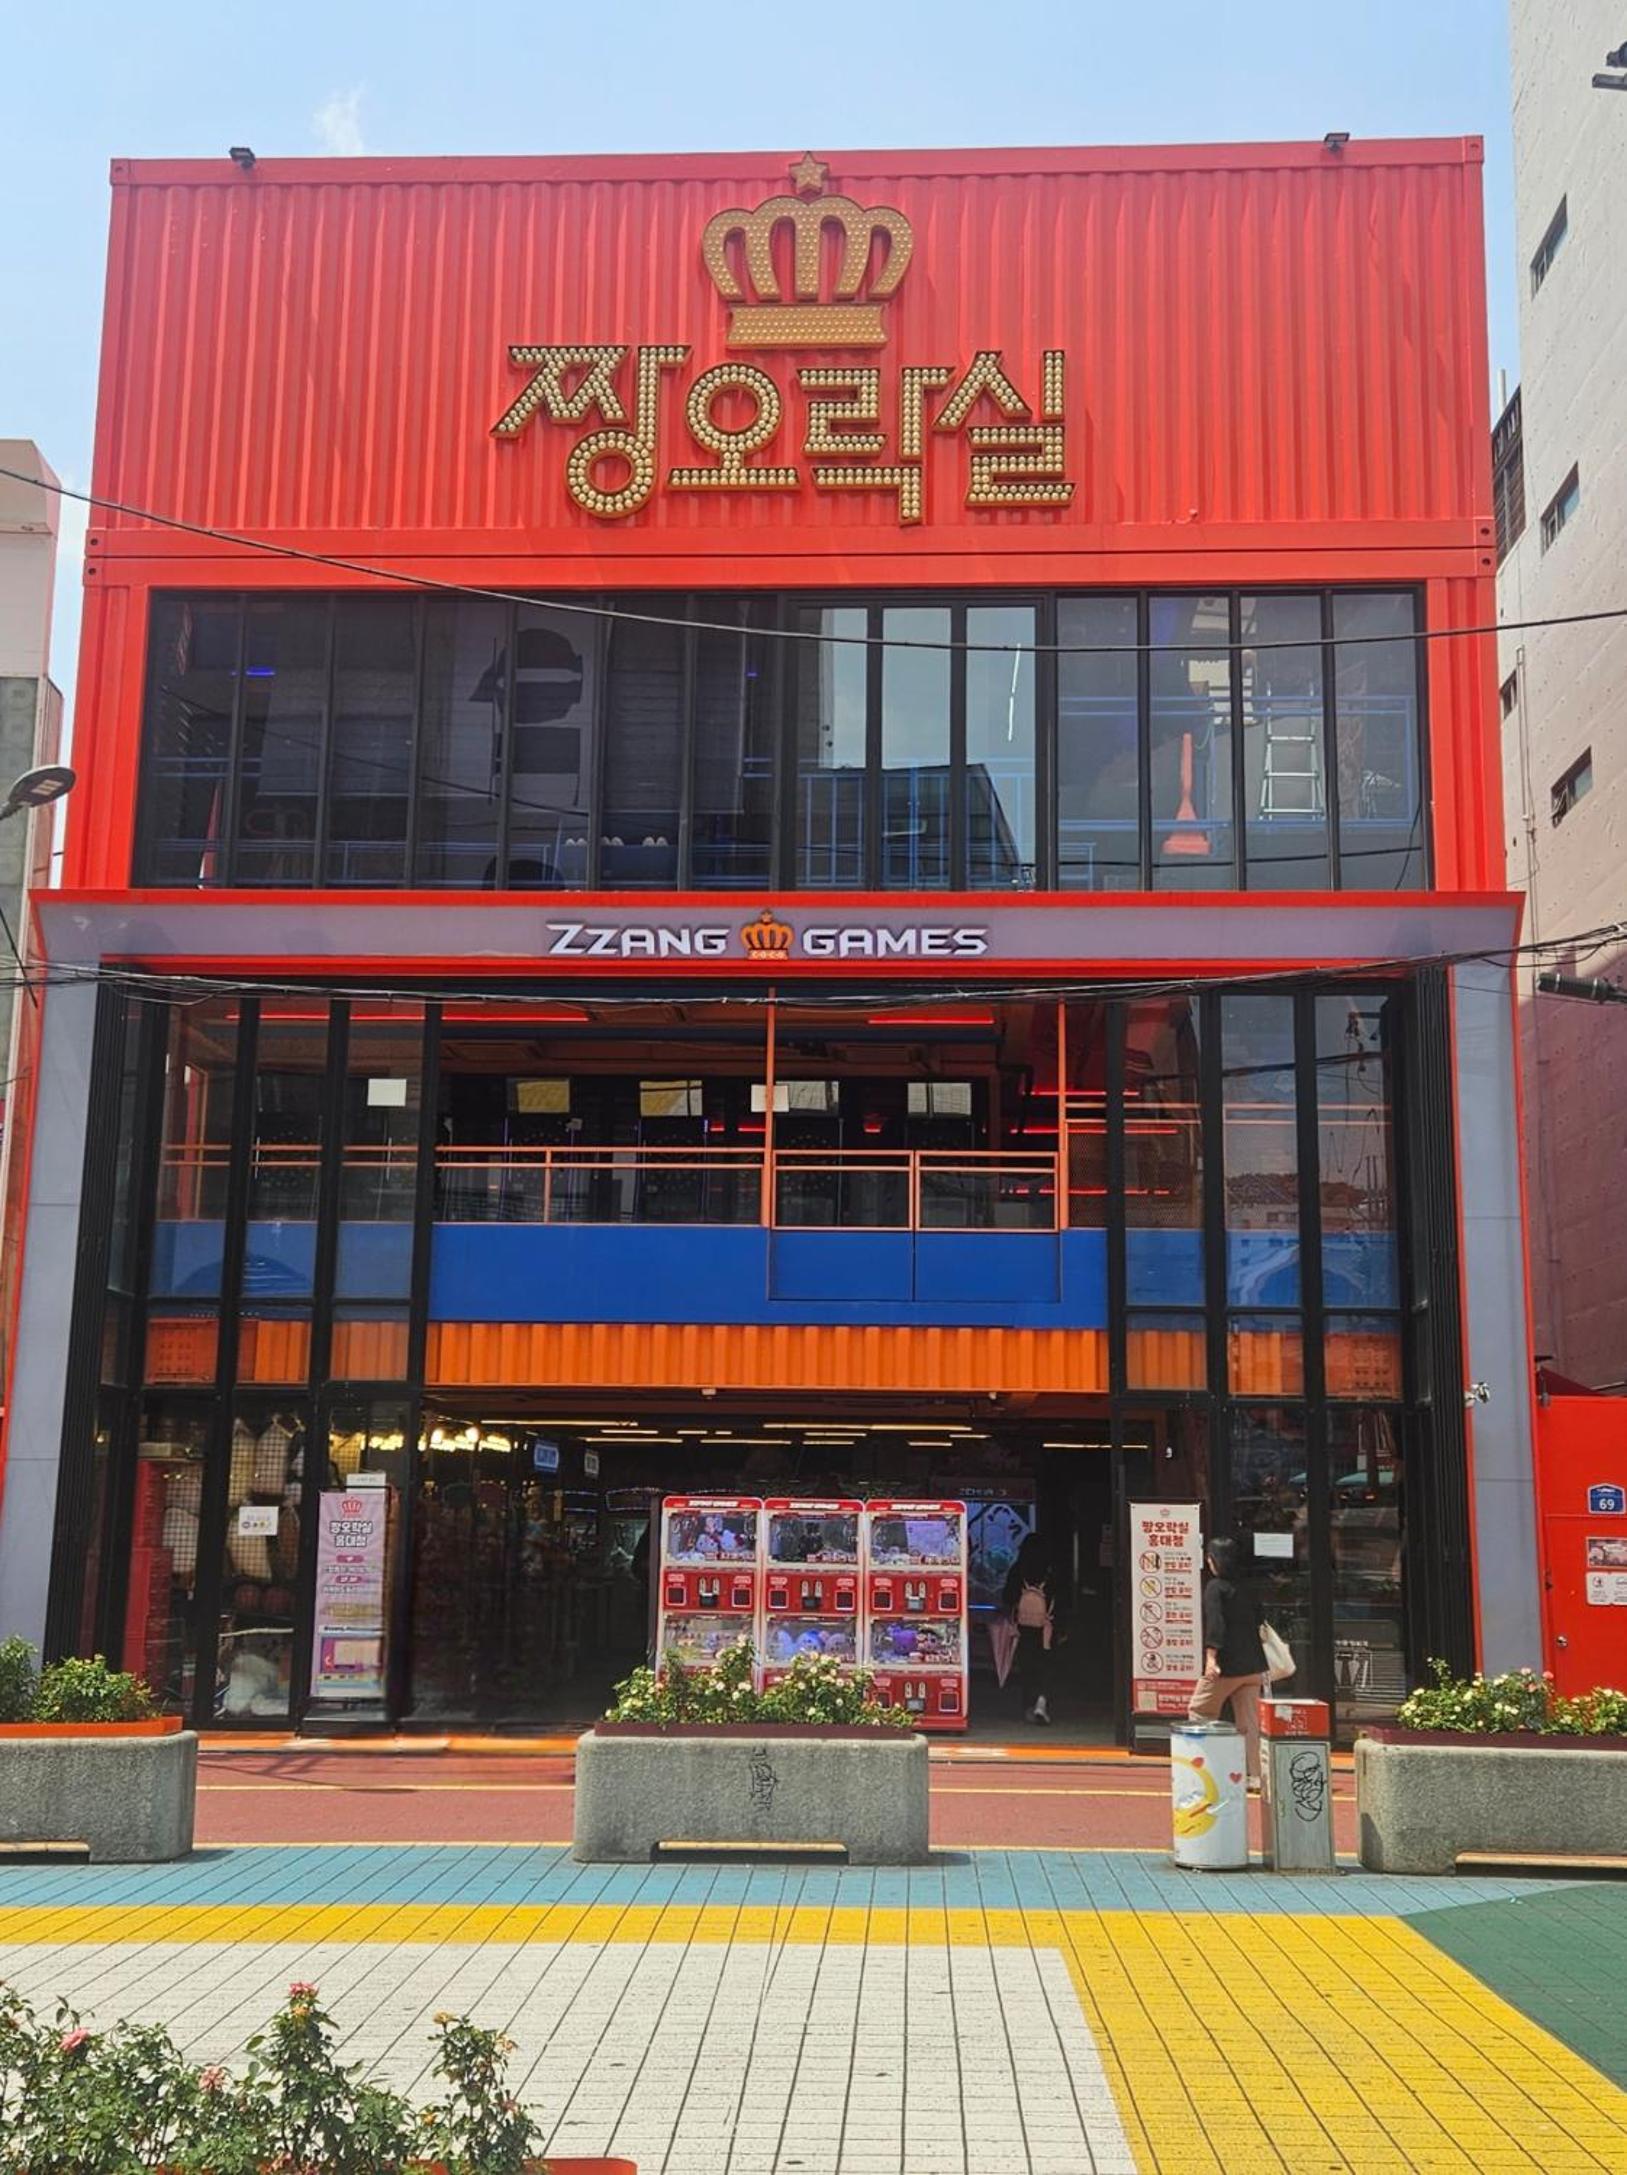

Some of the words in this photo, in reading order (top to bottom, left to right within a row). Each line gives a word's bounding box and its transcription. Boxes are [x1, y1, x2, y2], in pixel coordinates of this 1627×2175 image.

[489, 344, 1078, 526] 짱오락실
[546, 923, 730, 958] ZZANG
[803, 927, 989, 958] GAMES
[1599, 1498, 1615, 1510] 69
